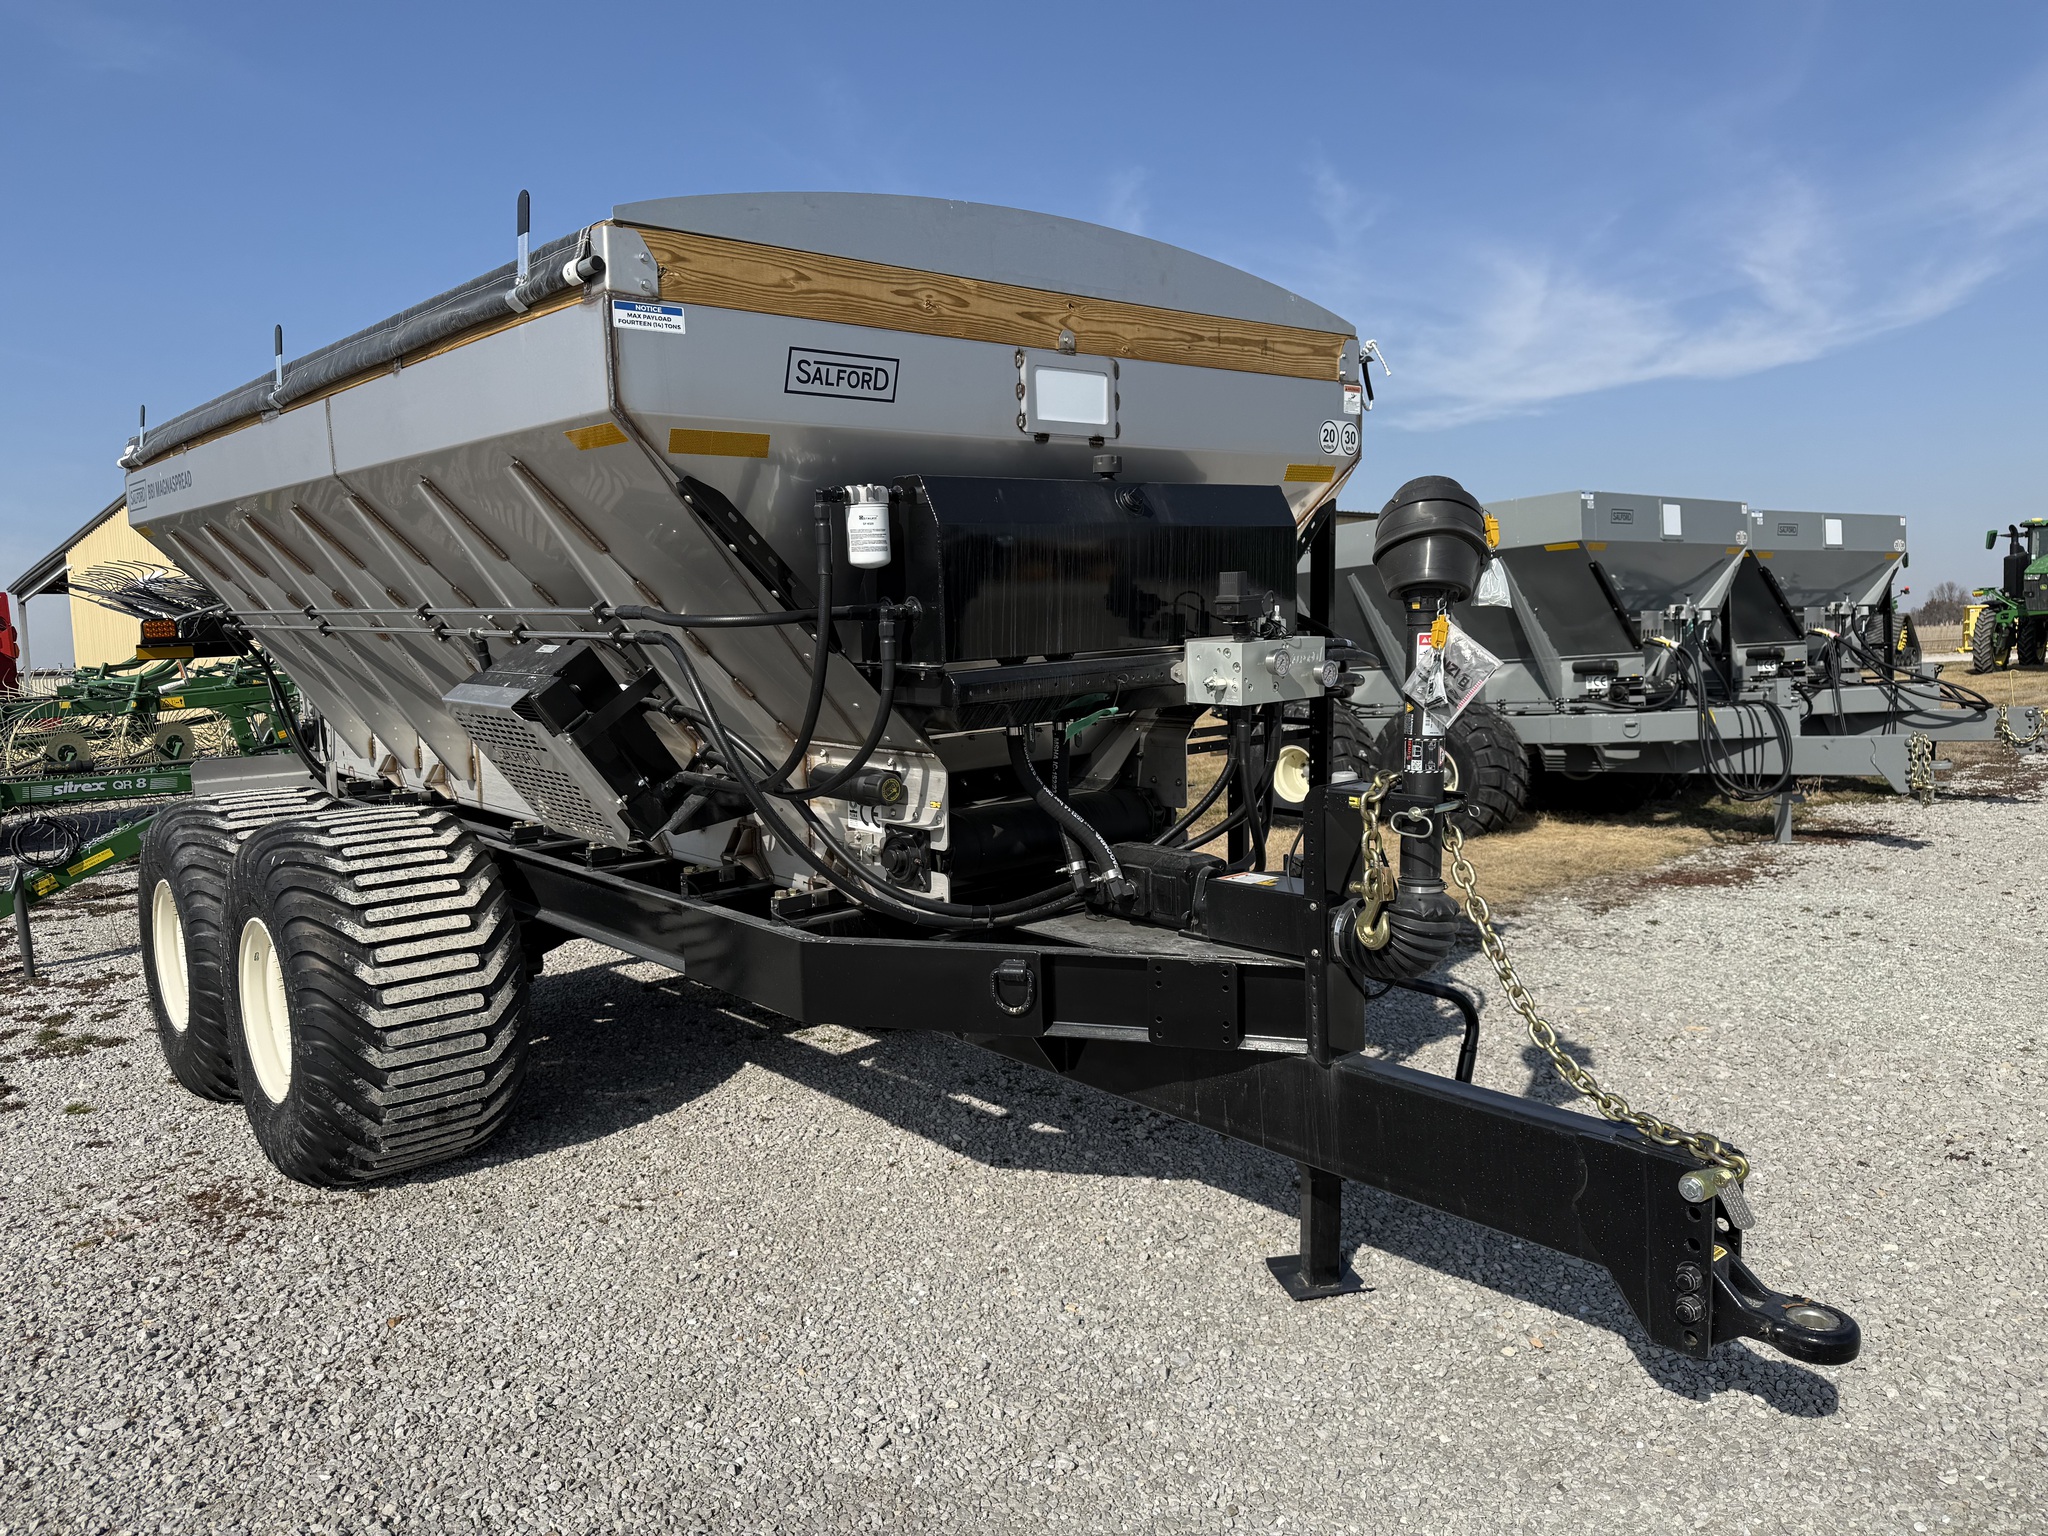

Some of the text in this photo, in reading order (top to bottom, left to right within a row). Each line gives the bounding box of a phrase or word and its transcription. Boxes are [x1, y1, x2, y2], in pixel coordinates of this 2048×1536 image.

[635, 305, 662, 313] NOTICE
[618, 318, 652, 327] FOURTEEN
[643, 314, 672, 322] PAYLOAD
[795, 359, 890, 391] SALFORD
[1323, 428, 1335, 443] 20
[1344, 431, 1356, 445] 30
[1593, 676, 1607, 687] CE
[53, 778, 147, 796] sitrex QR 8
